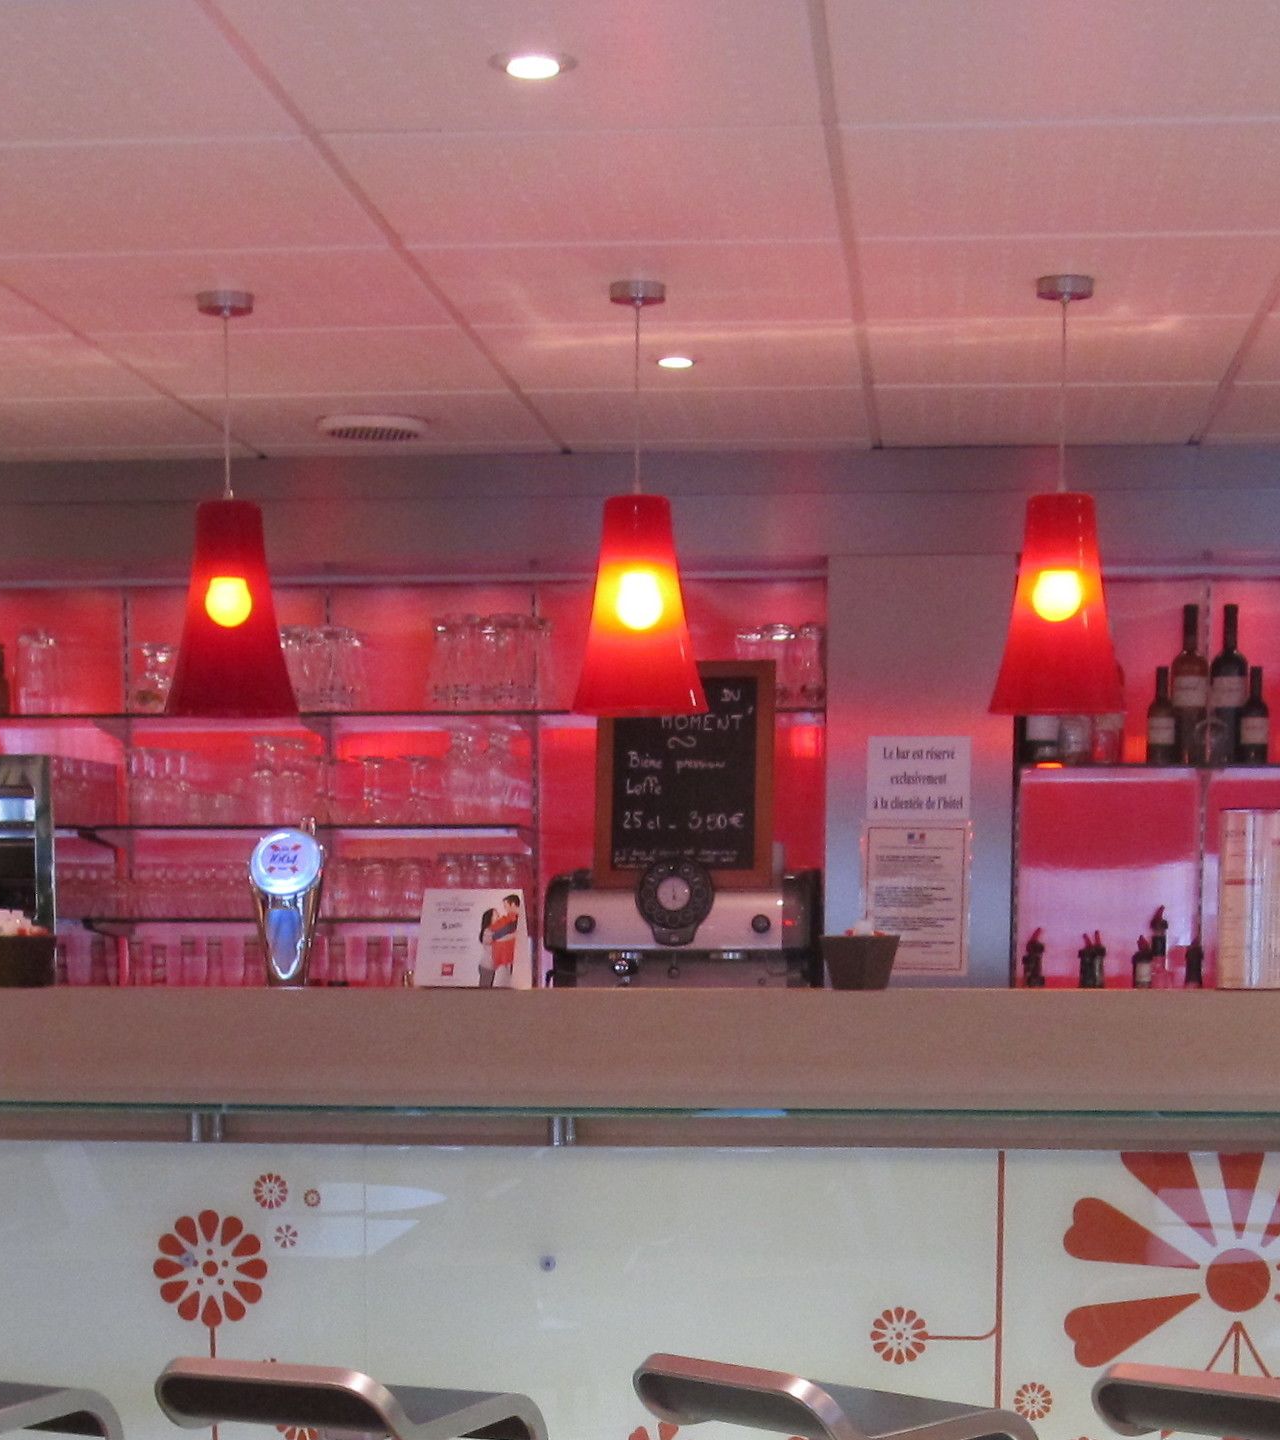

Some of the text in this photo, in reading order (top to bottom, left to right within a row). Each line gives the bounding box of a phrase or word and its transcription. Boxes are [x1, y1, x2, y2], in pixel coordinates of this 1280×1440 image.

[661, 714, 743, 731] MOMENT
[883, 746, 893, 760] Le
[896, 746, 910, 760] bar
[912, 748, 923, 760] est
[890, 770, 947, 785] exclusivement
[926, 795, 936, 810] de
[623, 811, 643, 829] 25
